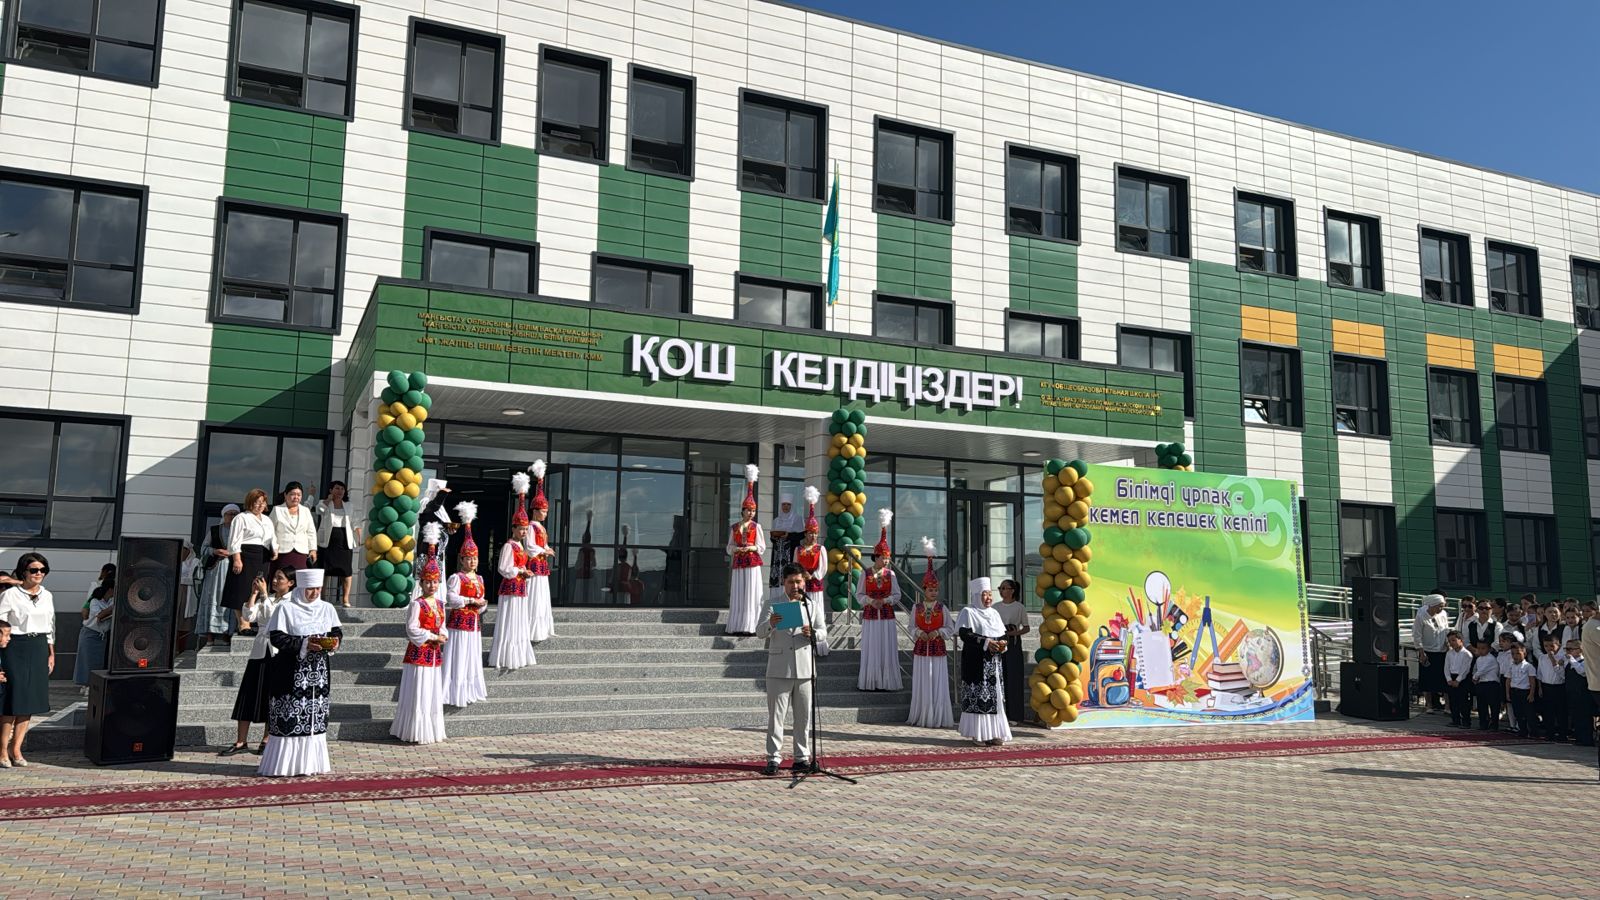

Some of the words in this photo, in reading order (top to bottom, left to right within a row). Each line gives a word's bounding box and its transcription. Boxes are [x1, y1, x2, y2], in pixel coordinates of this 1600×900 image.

[631, 333, 736, 382] ҚОШ
[771, 350, 1023, 409] КЕЛДІҢІЗДЕР!
[1182, 486, 1230, 508] ұрпақ
